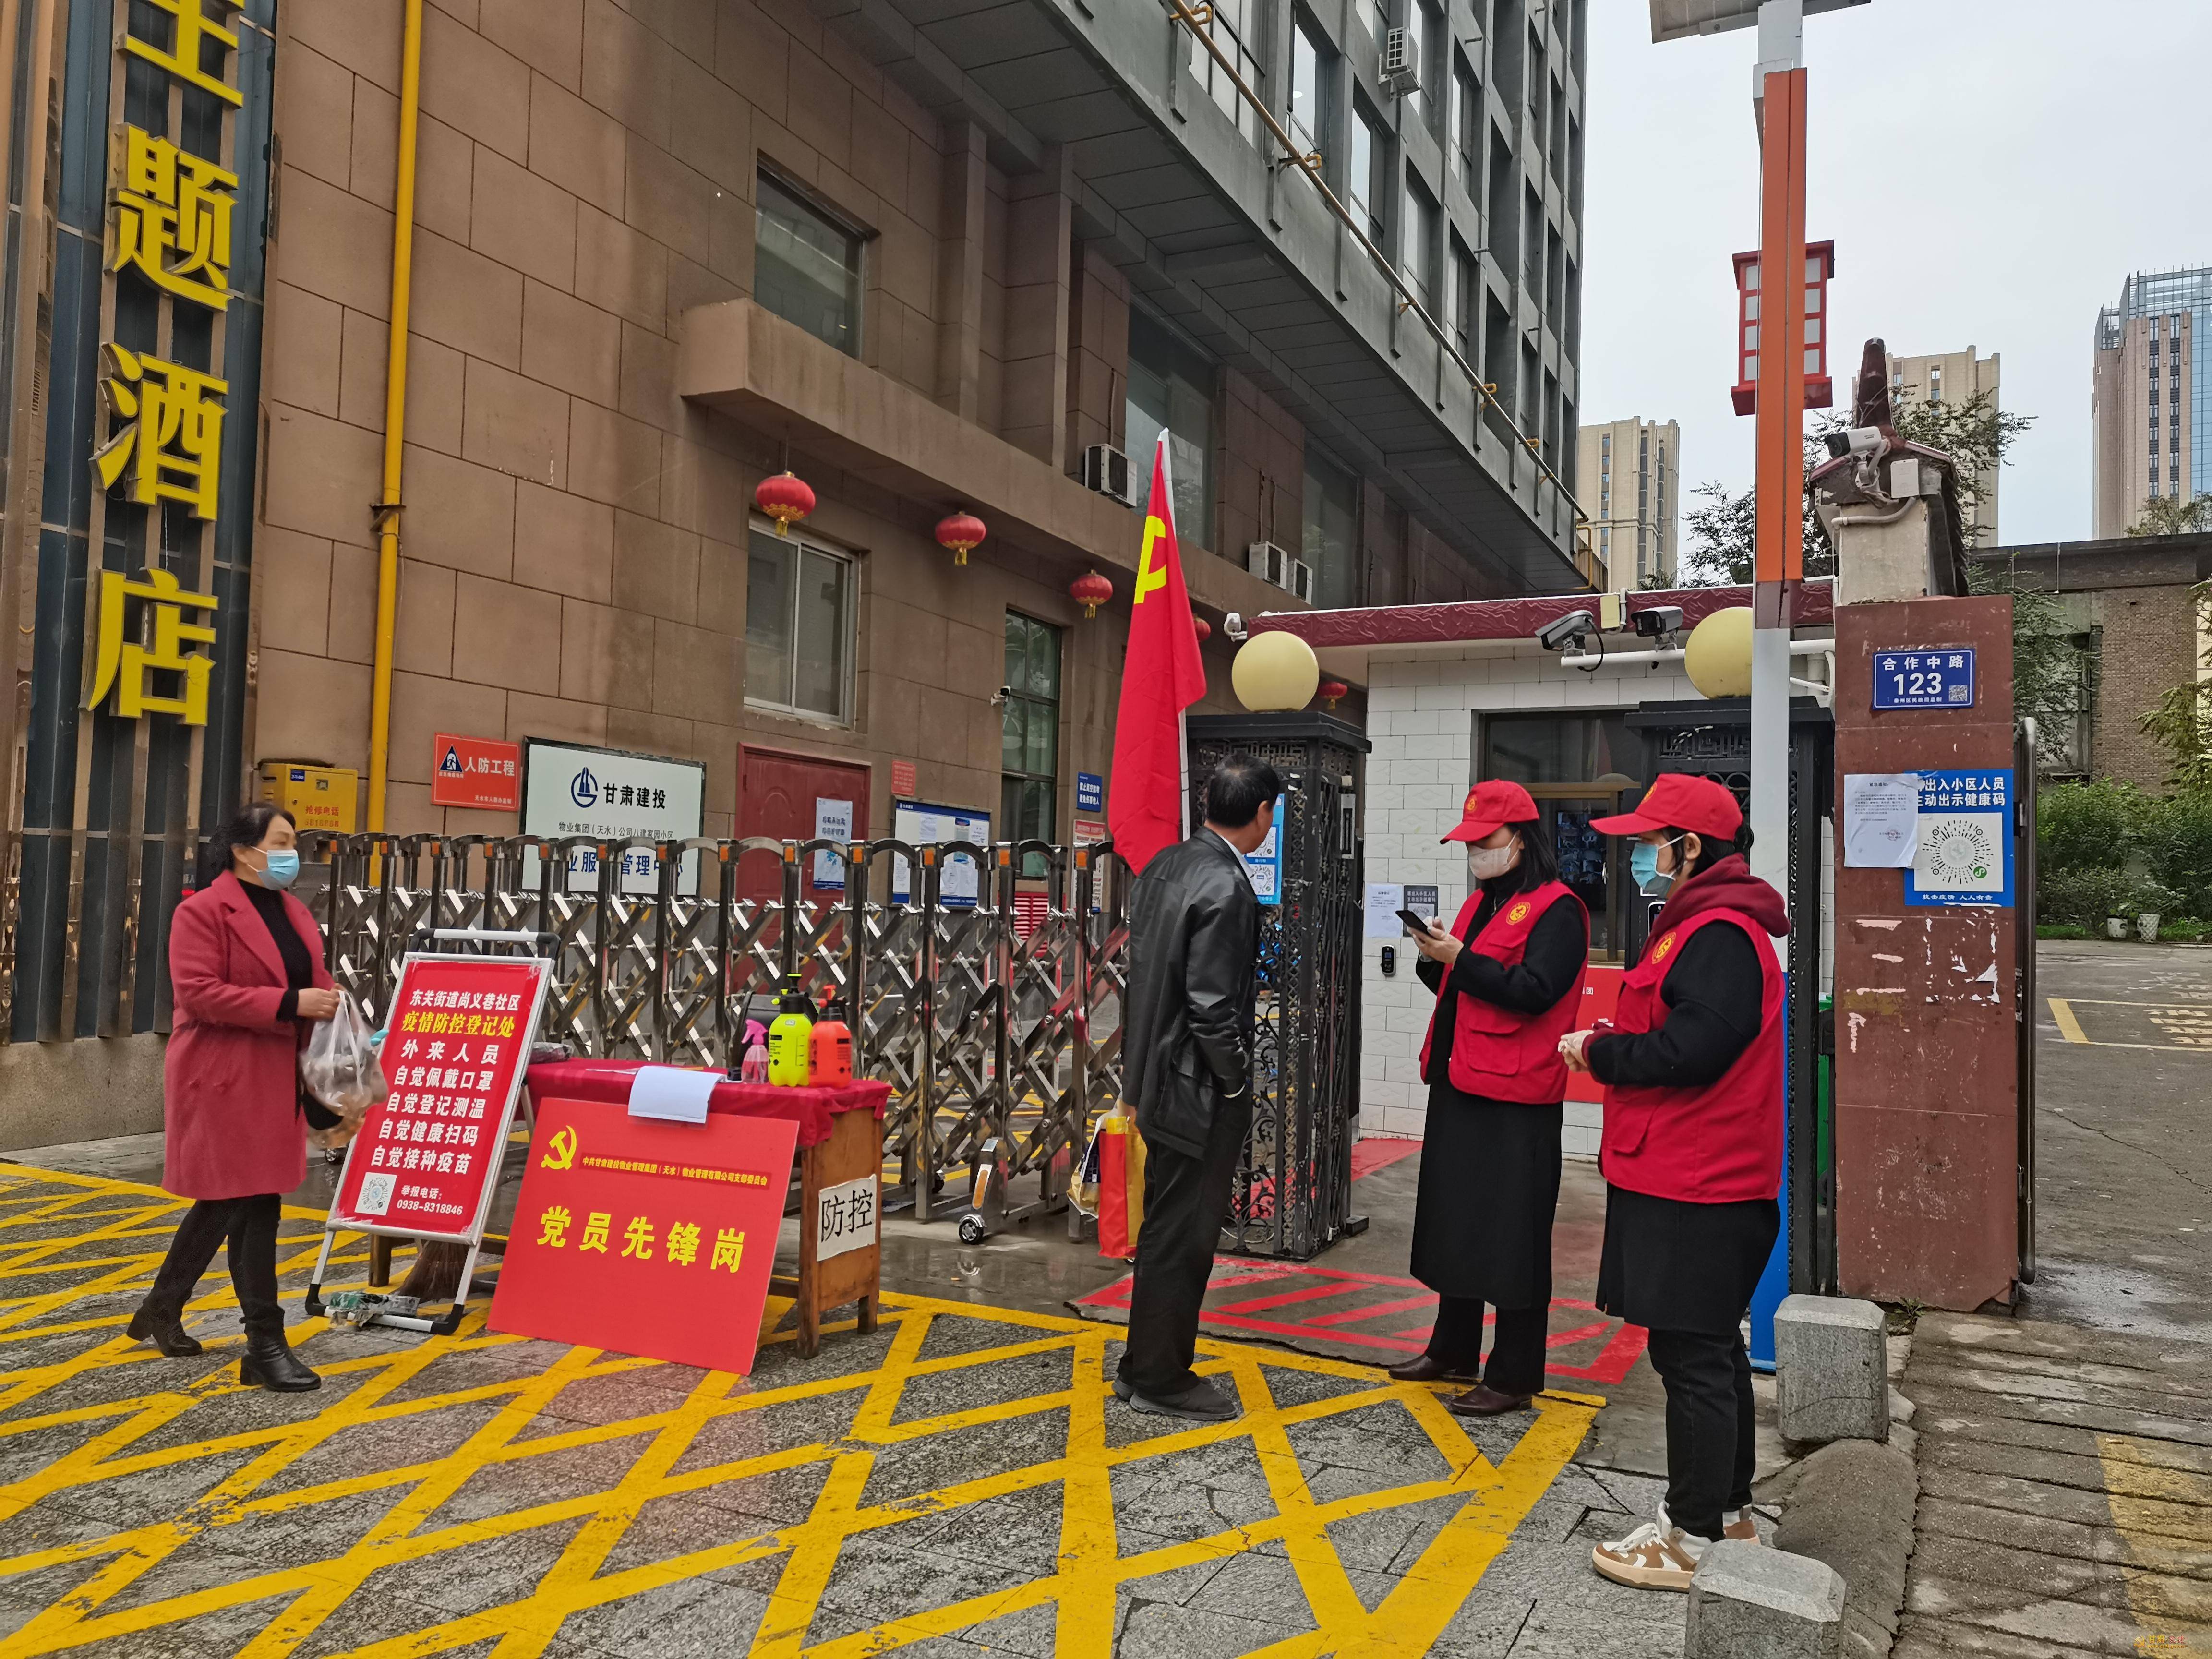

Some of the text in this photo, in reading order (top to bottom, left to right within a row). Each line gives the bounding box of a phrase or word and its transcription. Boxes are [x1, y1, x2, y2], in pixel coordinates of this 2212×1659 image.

[82, 0, 245, 727] 主题酒店
[1882, 654, 1964, 671] 合作中路
[1893, 672, 1942, 695] 123
[465, 756, 515, 776] 人防工程
[603, 782, 666, 810] 甘肃建投
[1918, 777, 2005, 792] 出入小区人员
[305, 805, 339, 817] 抢修电话
[409, 989, 521, 1011] 东关街道尚义巷社区
[401, 1010, 515, 1038] 疫情防控登记处
[400, 1038, 499, 1065] 外来人员
[394, 1065, 494, 1092] 自觉佩戴口罩
[386, 1091, 486, 1119] 自觉登记测温
[378, 1118, 479, 1147] 自觉健康扫码
[371, 1145, 472, 1175] 自觉接种疫苗
[397, 1199, 463, 1215] 0938-8318846
[821, 1189, 874, 1243] 防控
[536, 1205, 745, 1274] 党员先锋岗
